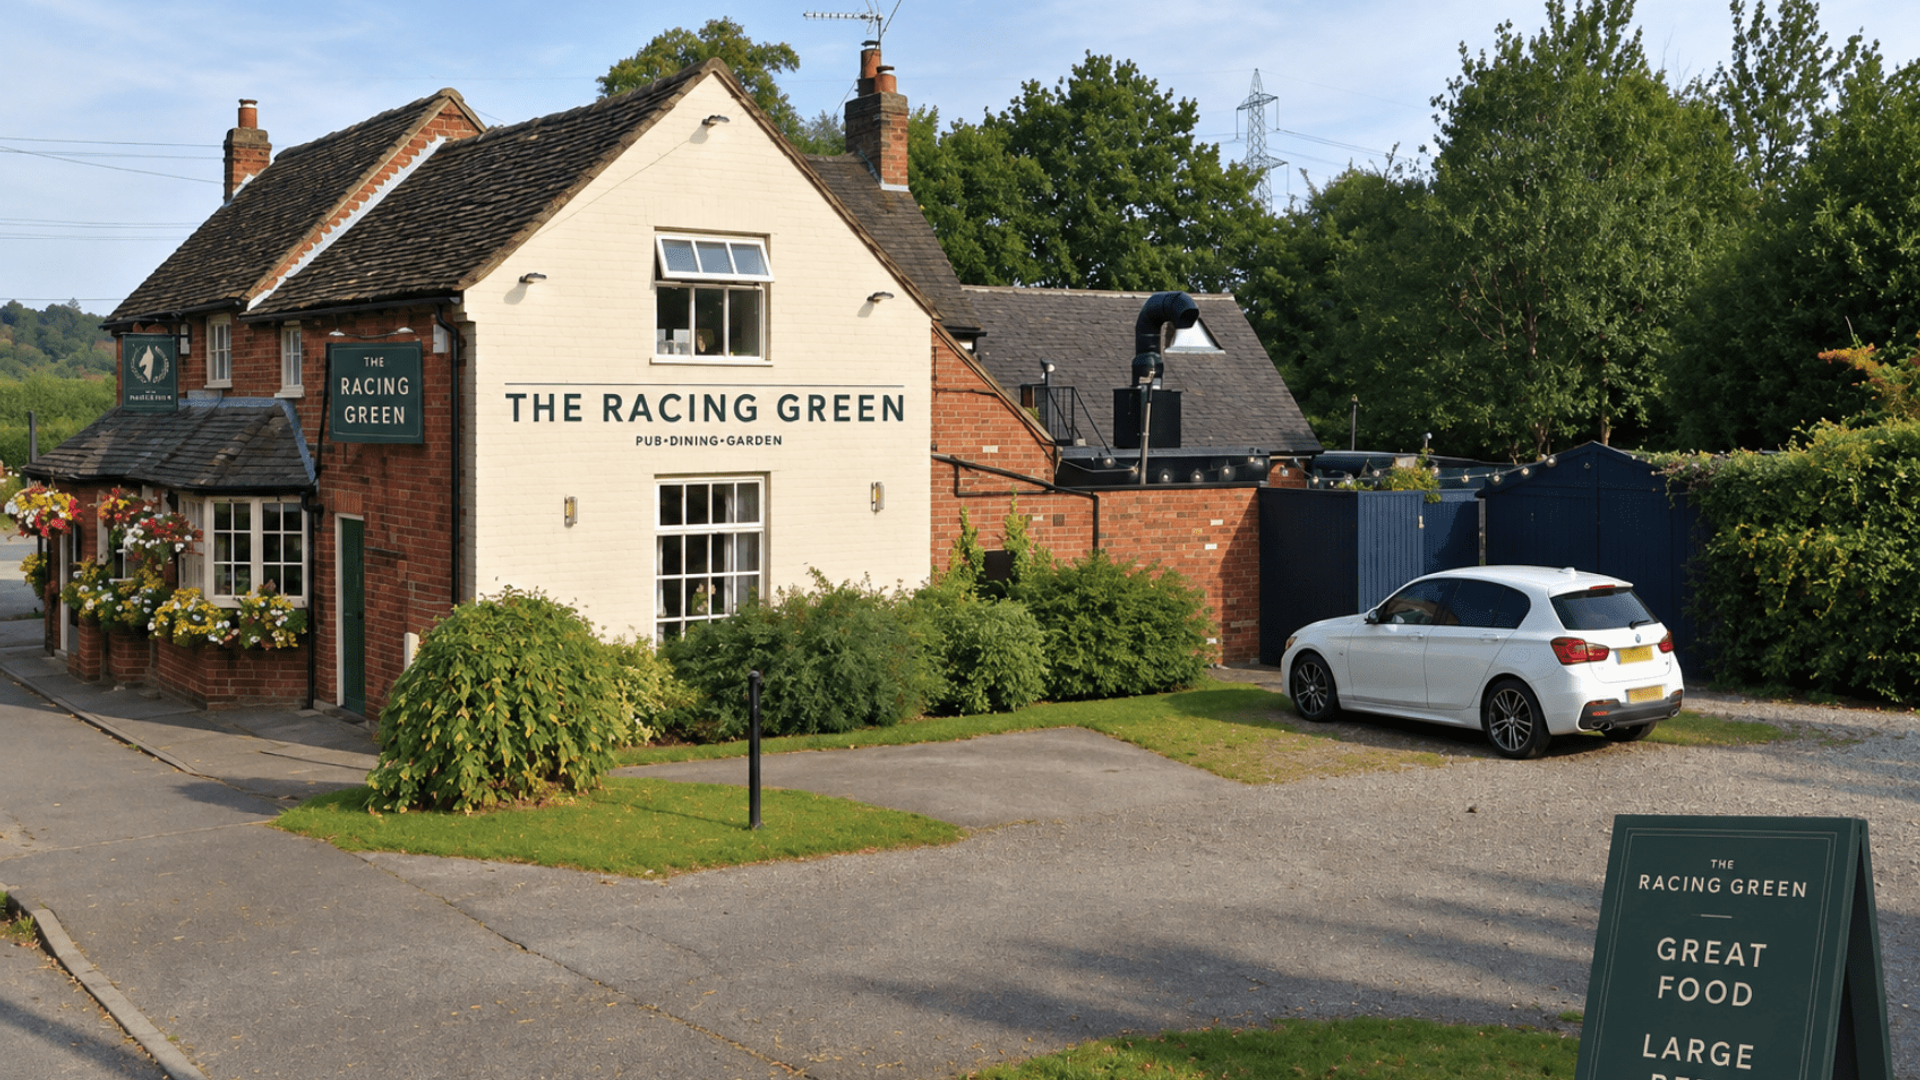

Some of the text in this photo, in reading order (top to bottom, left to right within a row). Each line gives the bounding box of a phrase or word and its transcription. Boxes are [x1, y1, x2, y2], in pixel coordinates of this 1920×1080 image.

[364, 356, 384, 367] THE
[341, 376, 409, 395] RACING
[344, 405, 405, 424] GREEN
[505, 393, 904, 422] THE RACING GREEN
[1711, 859, 1734, 869] THE
[1638, 874, 1808, 898] RACING GREEN
[1657, 937, 1768, 968] GREAT
[1657, 976, 1754, 1007] FOOD
[1642, 1033, 1754, 1070] LARGE
